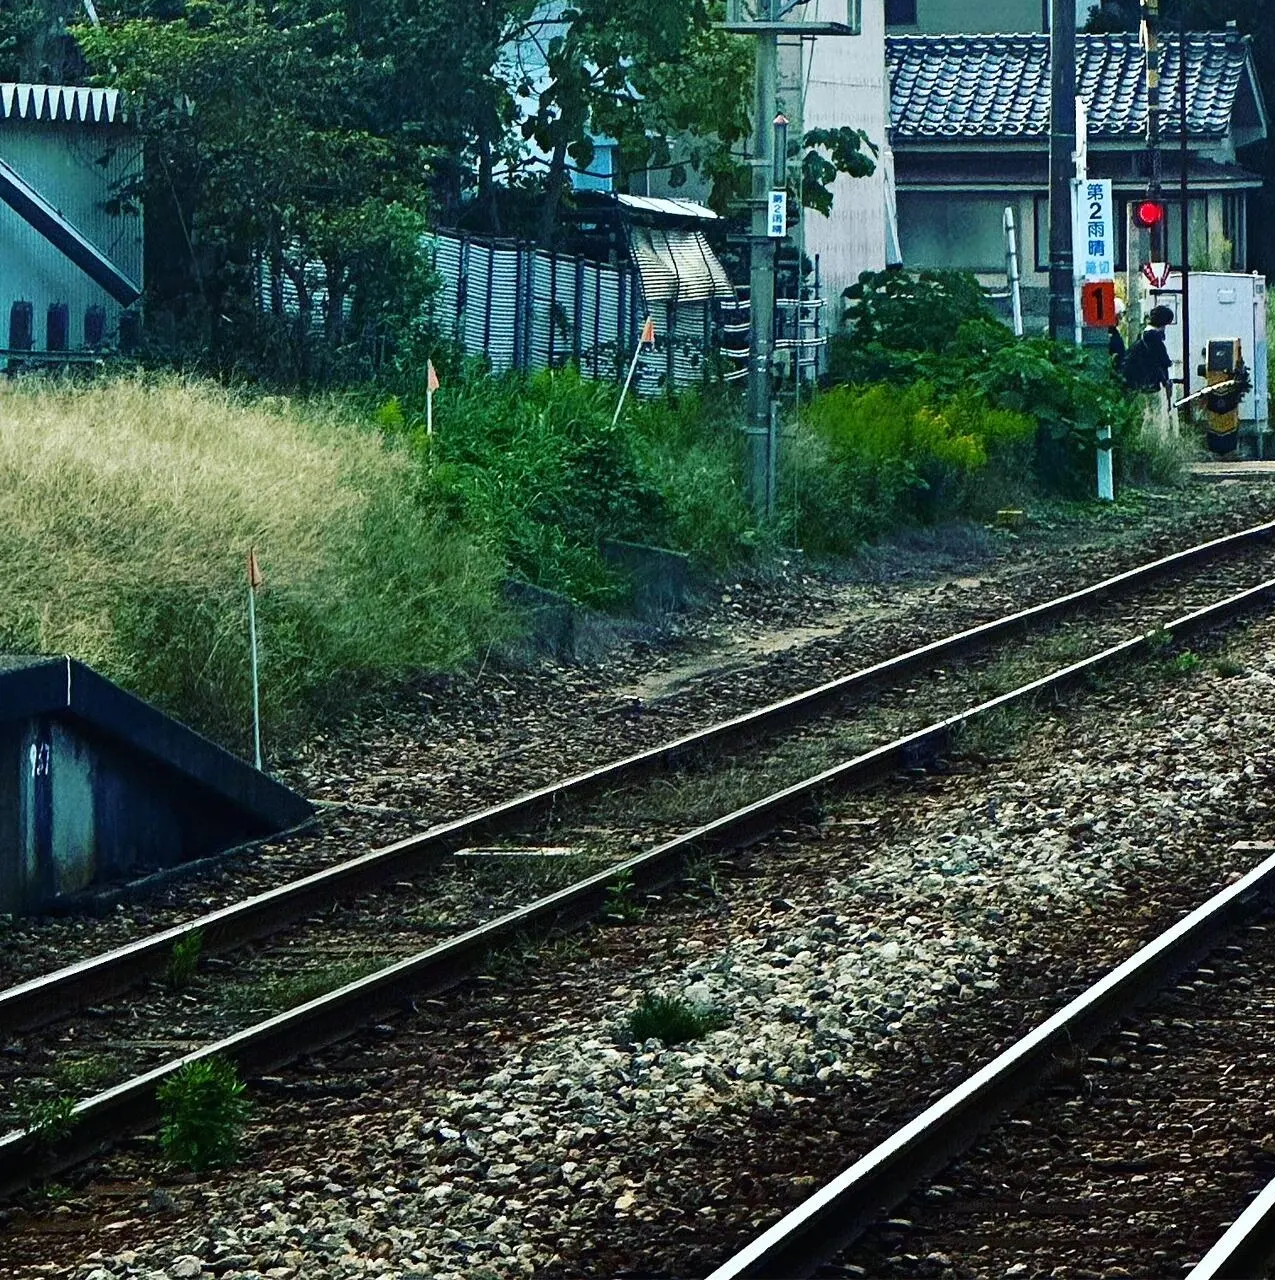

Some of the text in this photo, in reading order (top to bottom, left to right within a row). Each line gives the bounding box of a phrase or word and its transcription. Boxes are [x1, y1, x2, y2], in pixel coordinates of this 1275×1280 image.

[1086, 183, 1105, 257] 第2雨晴
[1092, 286, 1105, 320] 1
